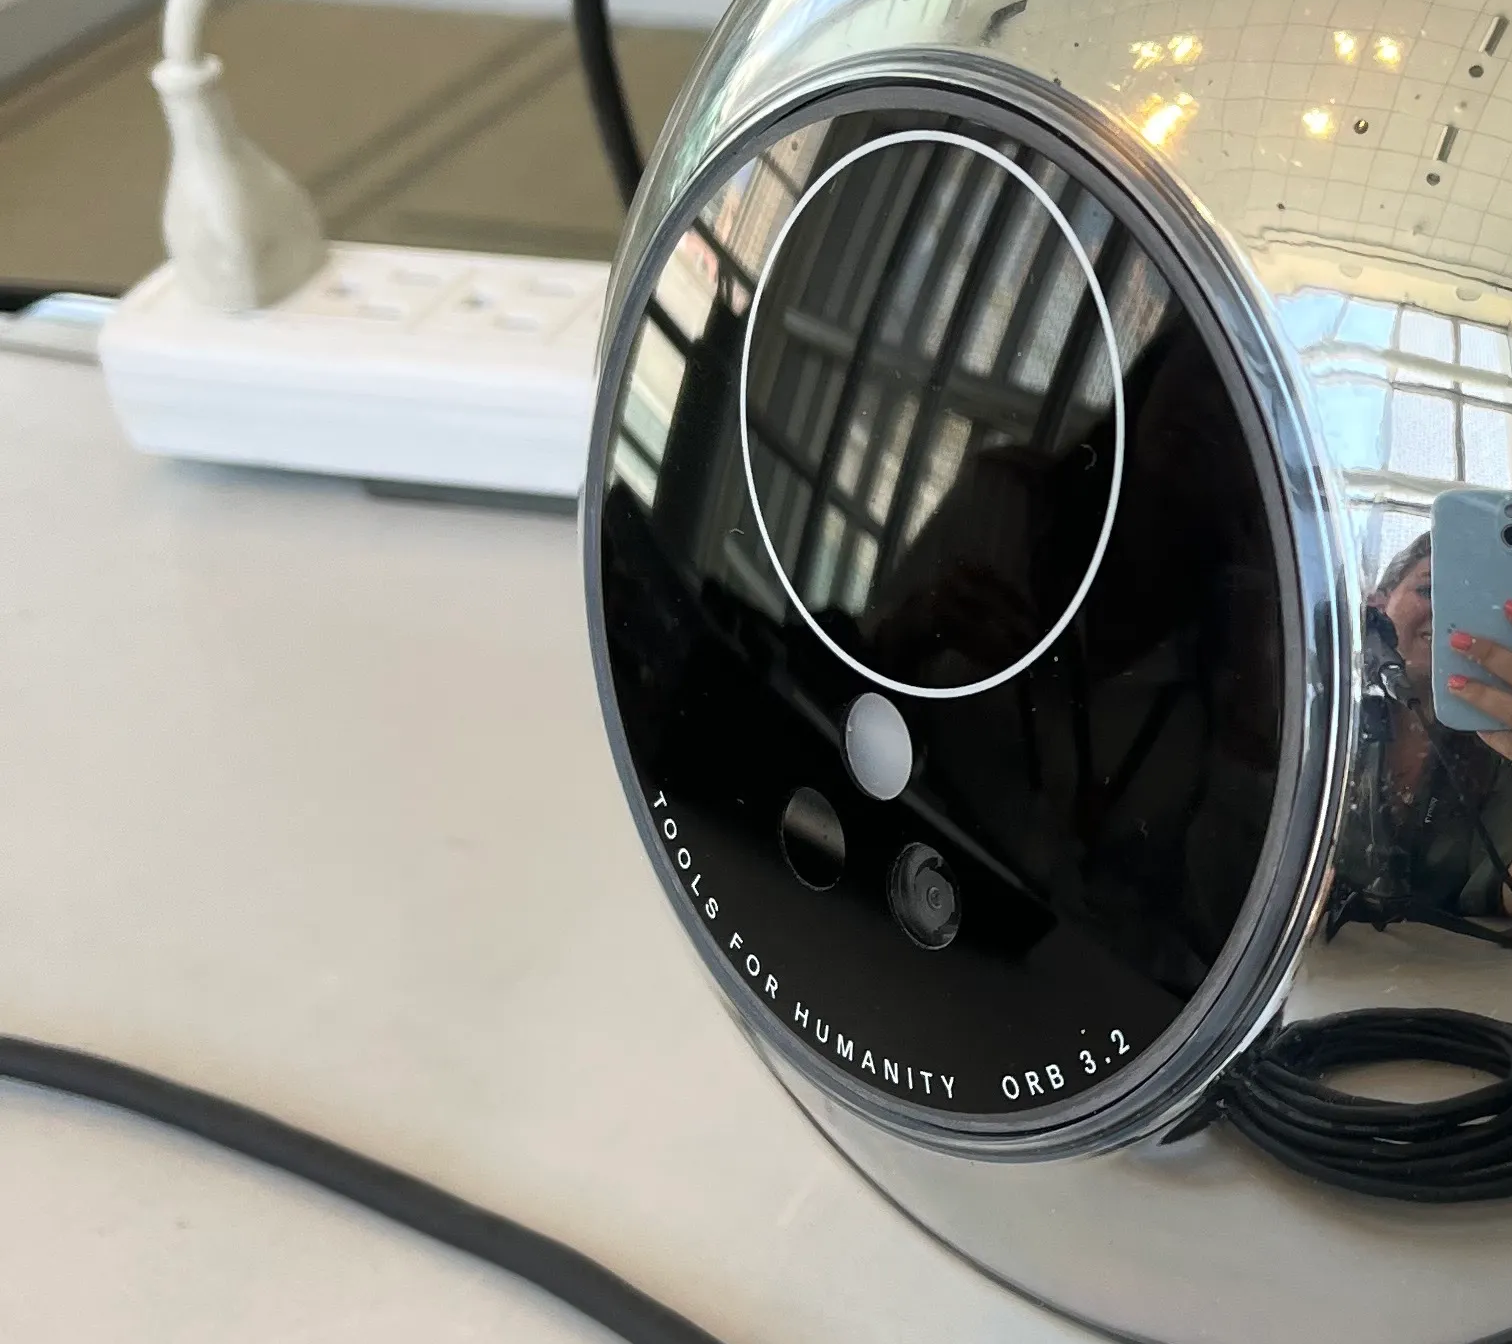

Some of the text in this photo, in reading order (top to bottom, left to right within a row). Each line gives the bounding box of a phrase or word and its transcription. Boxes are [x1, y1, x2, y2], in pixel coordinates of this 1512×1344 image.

[653, 791, 1130, 1100] TOOLS FOR HUMANITY ORB 3.2
